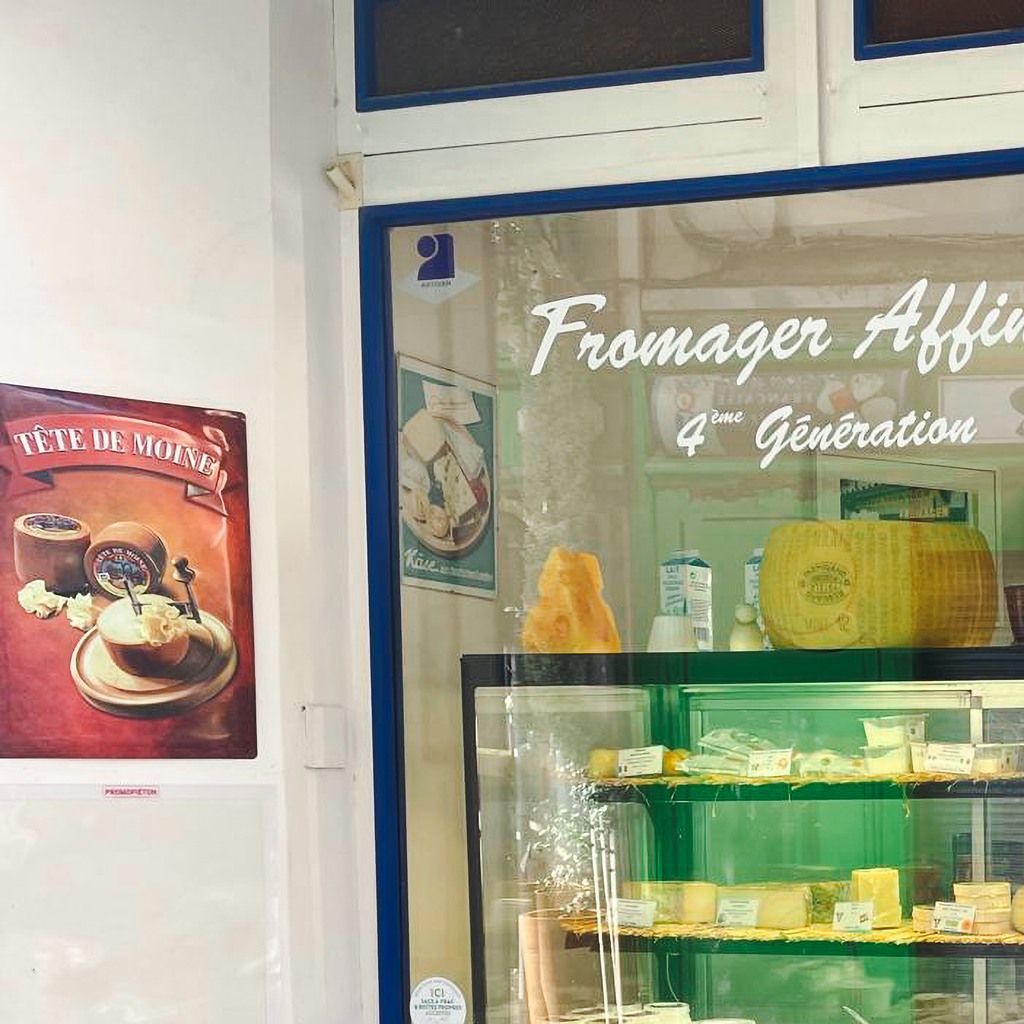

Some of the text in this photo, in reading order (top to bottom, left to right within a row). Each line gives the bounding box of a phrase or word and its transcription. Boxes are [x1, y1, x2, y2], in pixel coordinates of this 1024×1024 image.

[530, 293, 832, 386] Fromager
[14, 425, 218, 476] TÊTE DE MOINE
[676, 404, 977, 469] 4ème Génération
